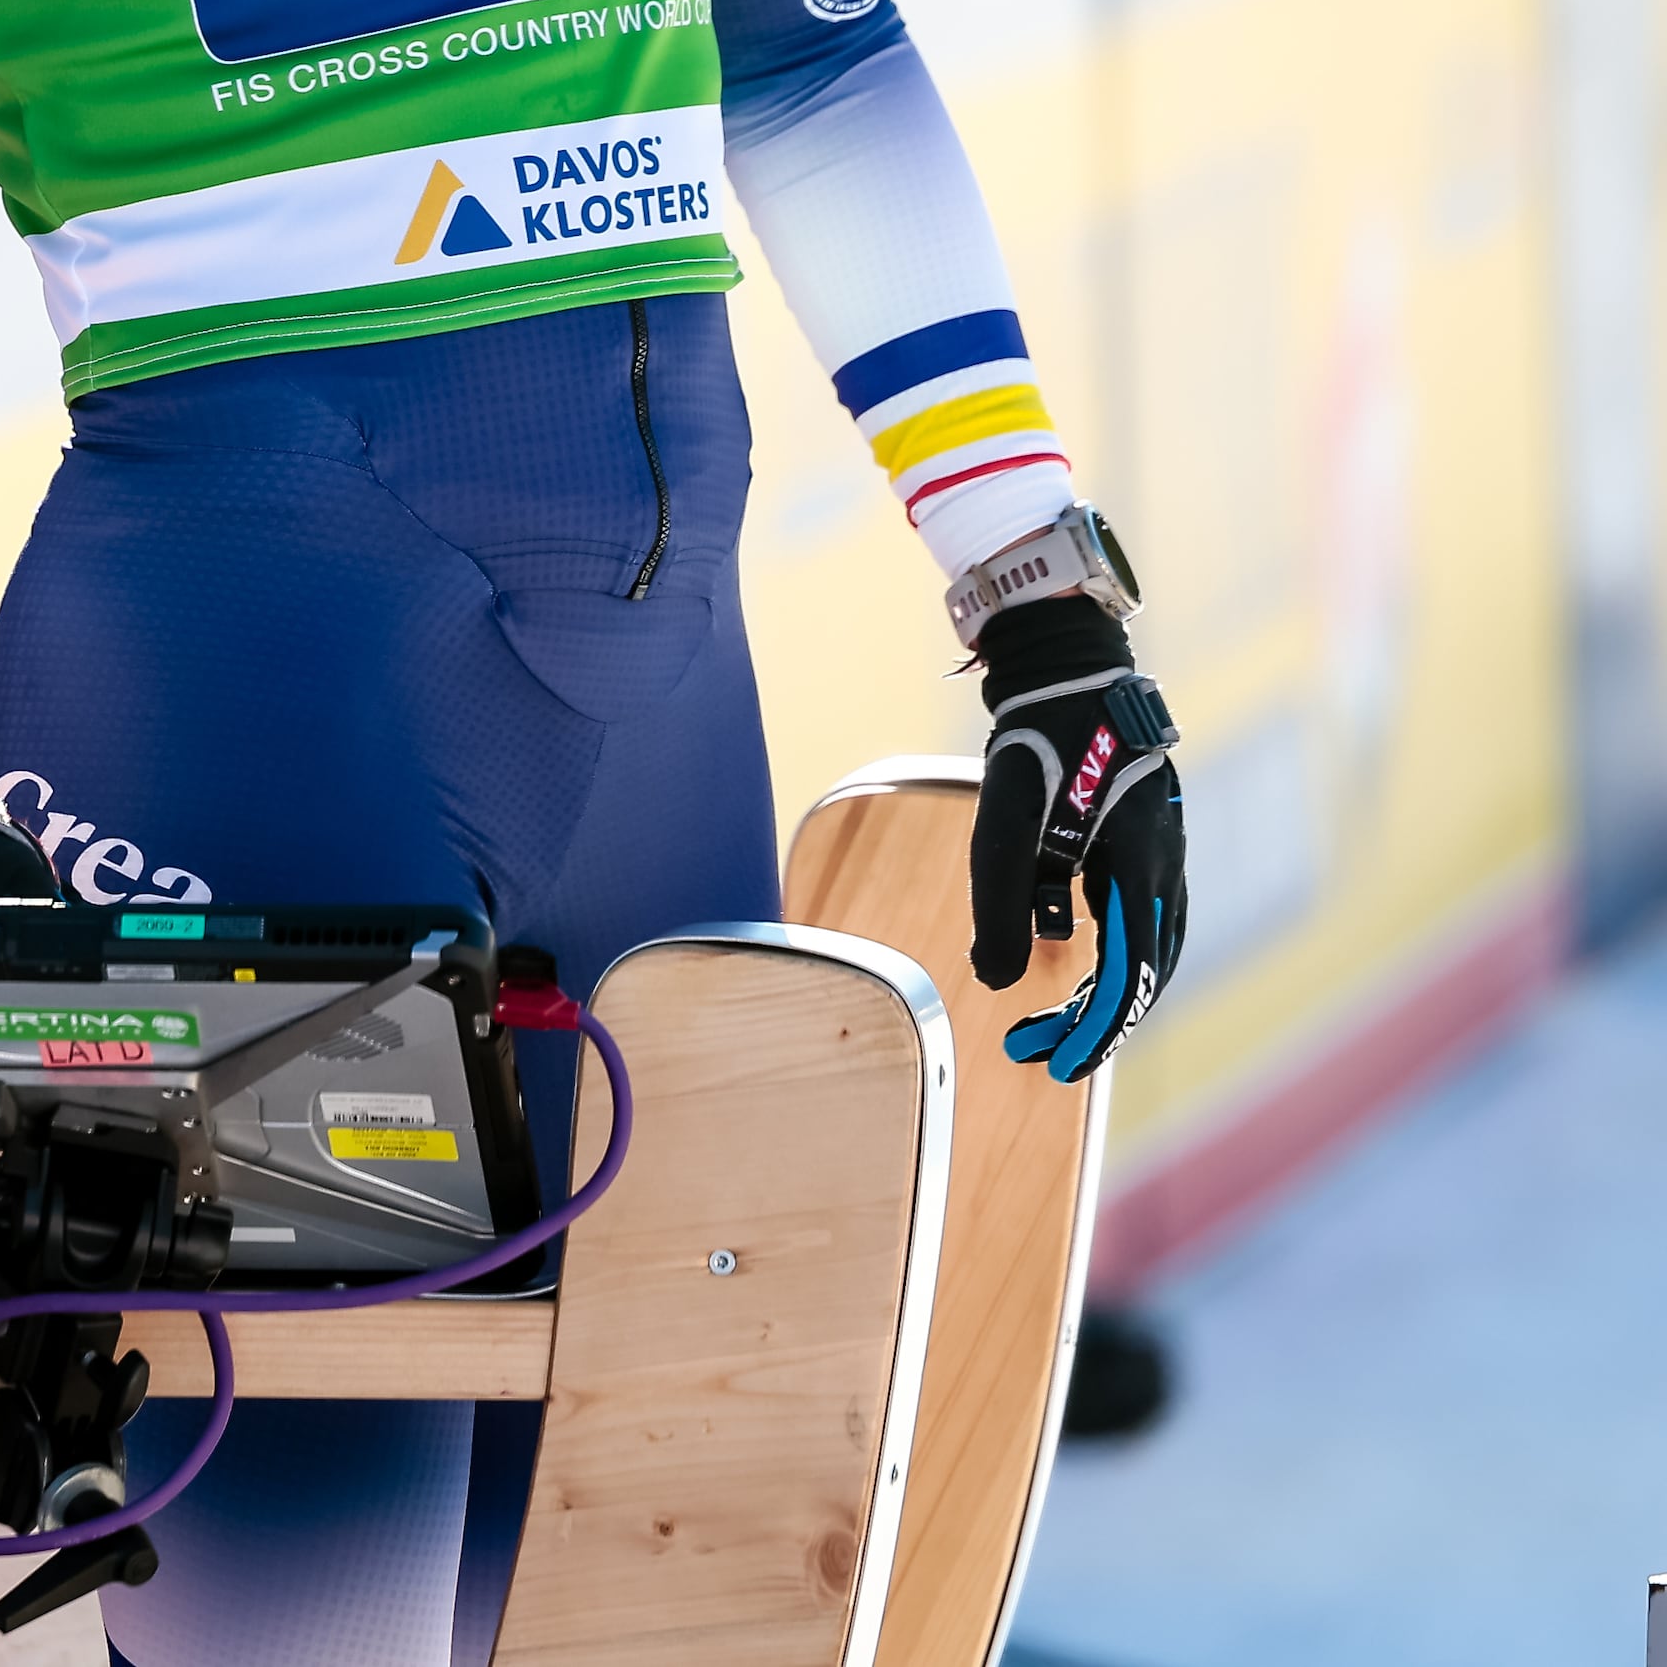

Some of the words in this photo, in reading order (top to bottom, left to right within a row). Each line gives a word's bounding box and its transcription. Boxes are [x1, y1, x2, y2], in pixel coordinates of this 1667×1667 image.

[210, 72, 277, 113] FIS
[287, 39, 431, 94] CROSS
[441, 6, 610, 63] COUNTRY
[513, 135, 662, 195] DAVOS
[522, 180, 711, 245] KLOSTERS
